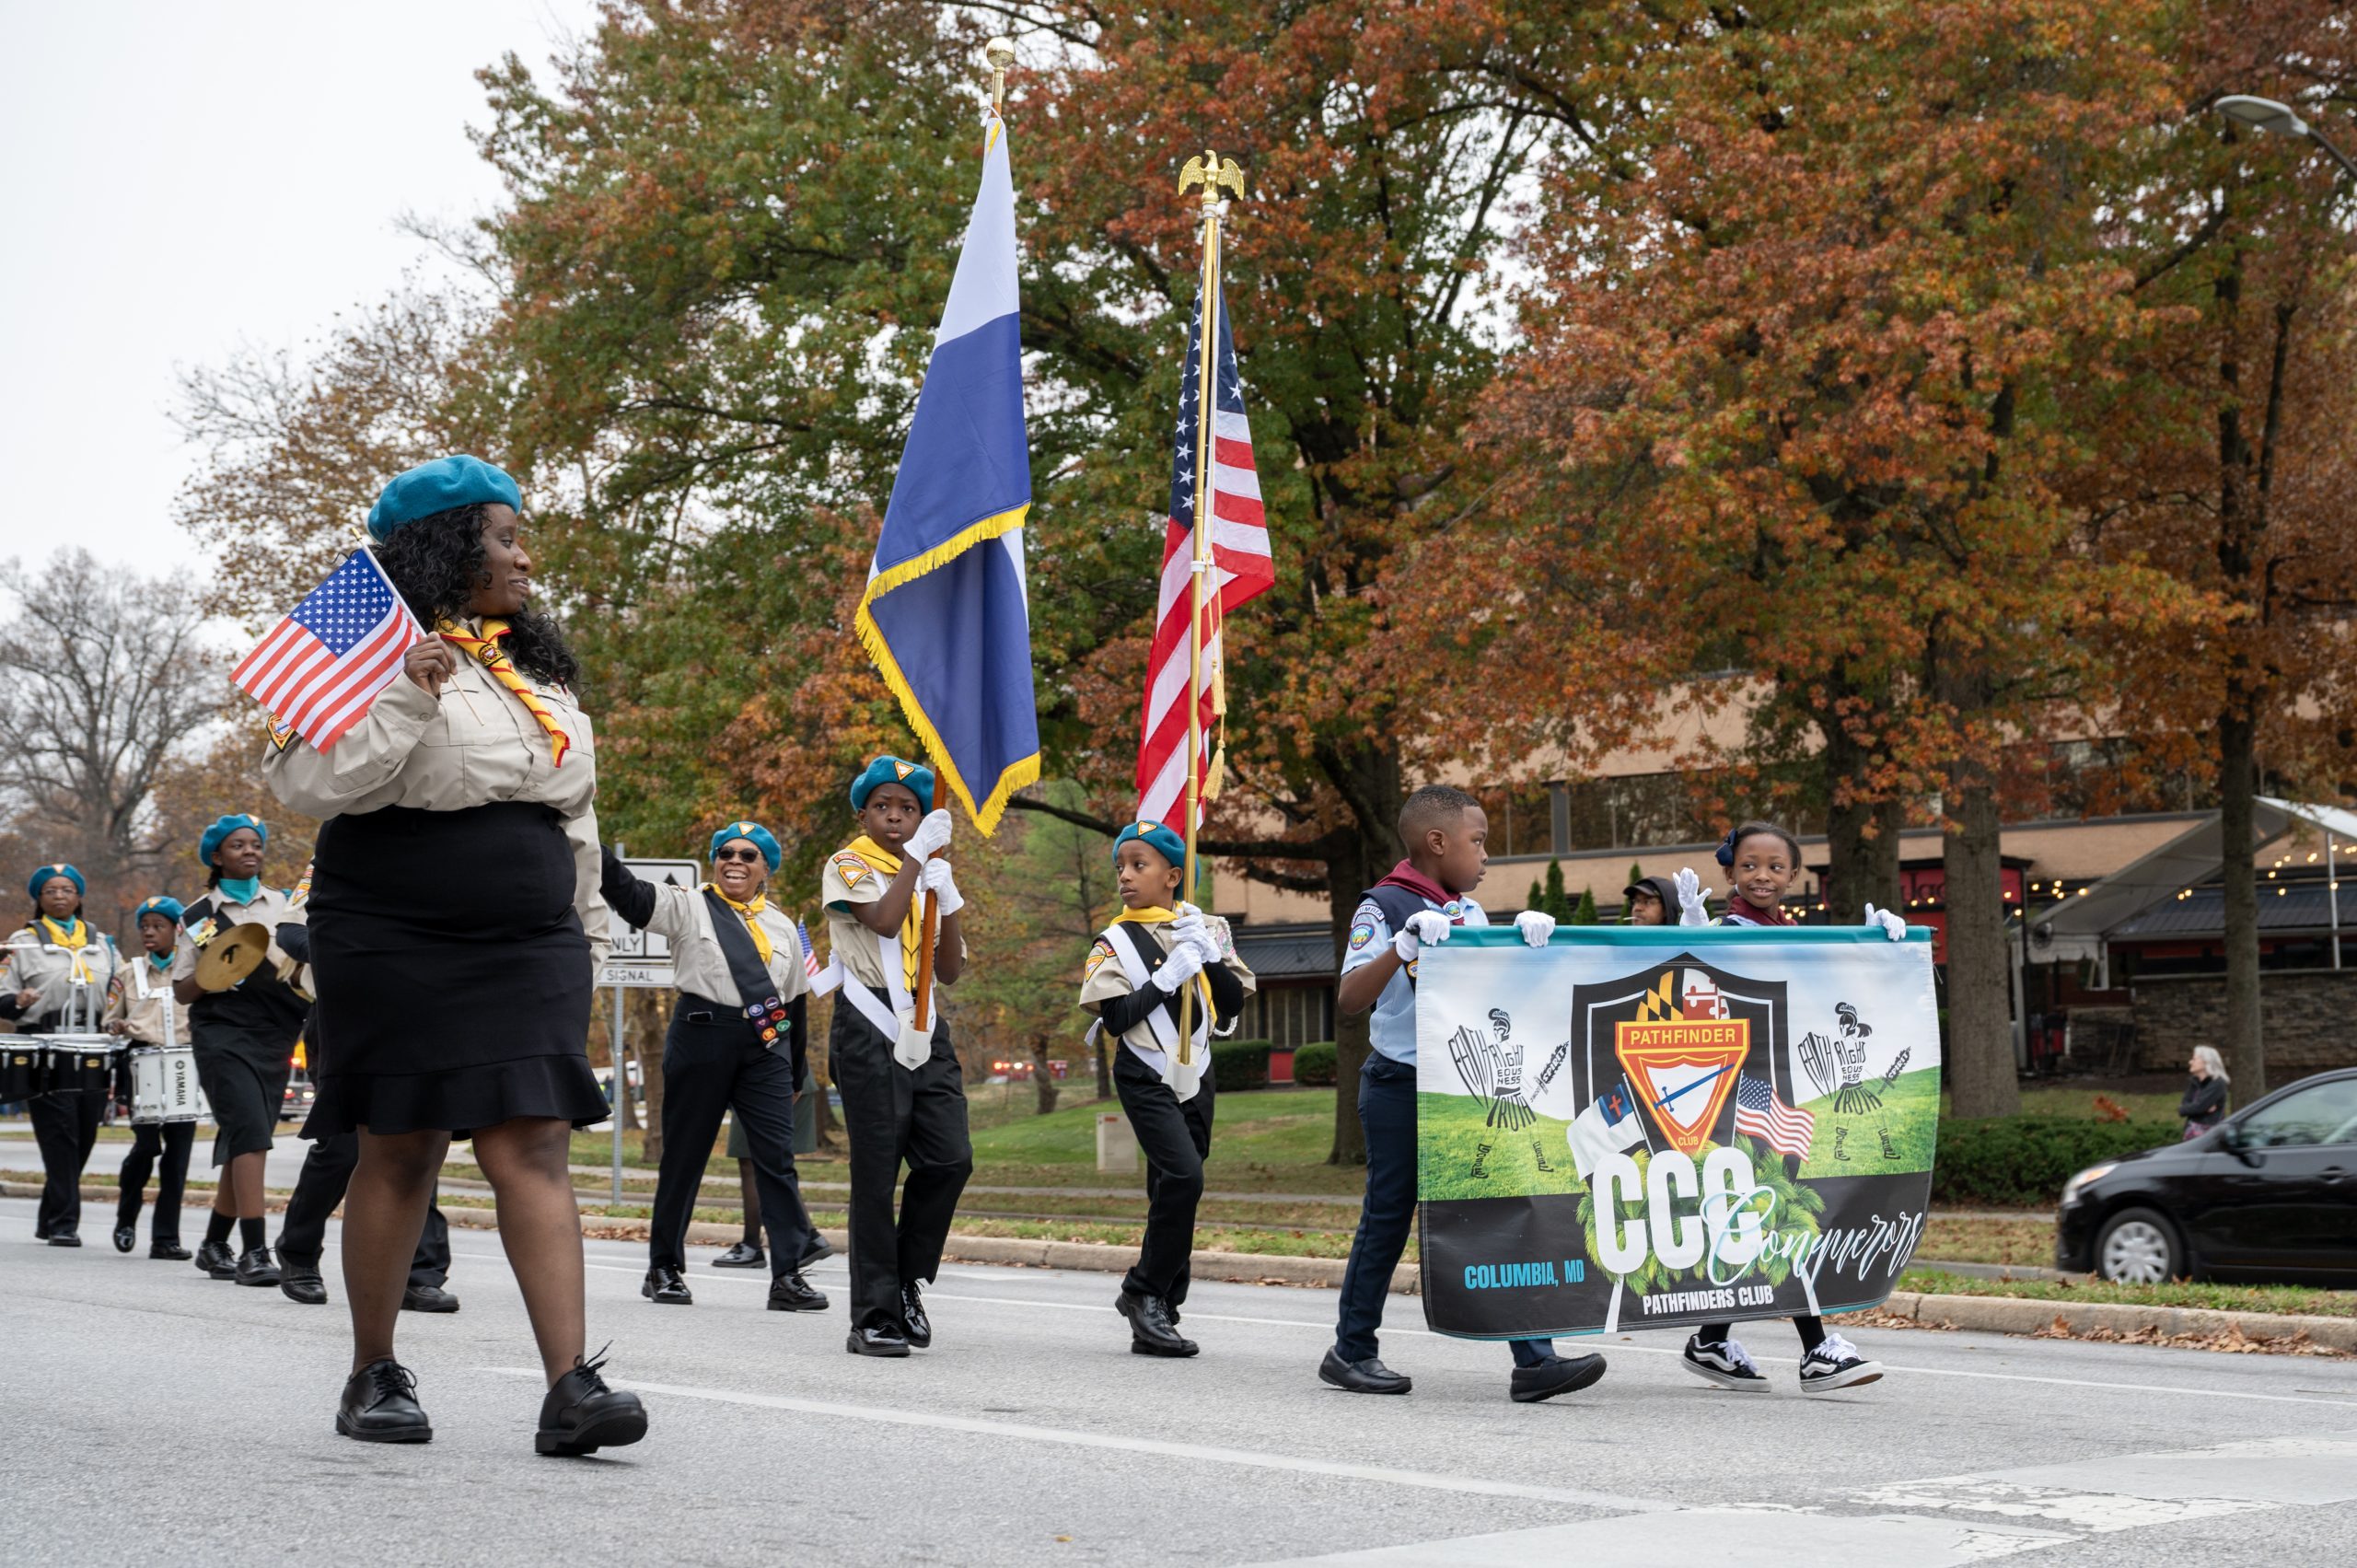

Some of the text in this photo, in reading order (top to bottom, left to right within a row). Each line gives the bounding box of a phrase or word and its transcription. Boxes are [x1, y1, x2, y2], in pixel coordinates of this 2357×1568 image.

[611, 937, 641, 952] NLY
[607, 970, 654, 982] SIGNAL
[1631, 1028, 1736, 1045] PATHFINDER
[1488, 1044, 1524, 1068] RIGHT
[1834, 1040, 1865, 1065] RIGHT
[1448, 1025, 1494, 1109] FAITH
[1497, 1068, 1522, 1077] EOUS
[1798, 1031, 1837, 1101] FAITH
[1841, 1066, 1864, 1074] EOUS
[1841, 1074, 1860, 1082] NESS
[176, 1071, 186, 1107] YAMAHA
[1497, 1076, 1521, 1086] NESS
[1487, 1093, 1537, 1132] TRUTH
[1834, 1086, 1883, 1115] TRUTH
[1678, 1135, 1699, 1146] CLUB
[1592, 1147, 1763, 1273] CCC
[1700, 1185, 1923, 1287] Conquerors
[1464, 1260, 1585, 1289] COLUMBIA, MD
[1643, 1284, 1774, 1315] PATHFINDERS CLUB
